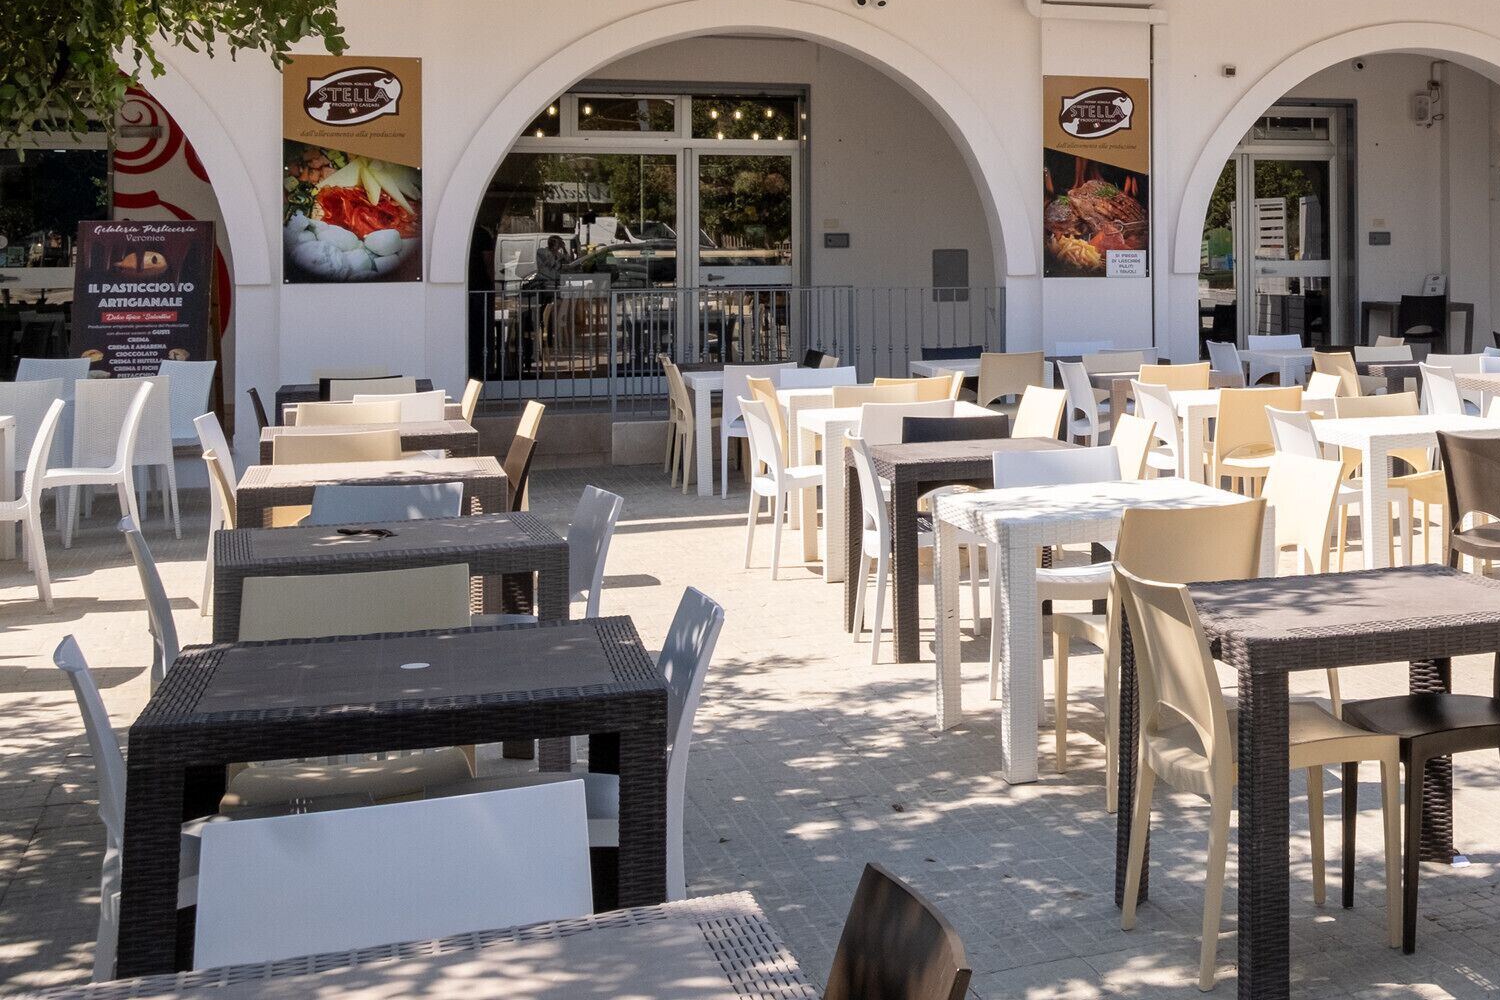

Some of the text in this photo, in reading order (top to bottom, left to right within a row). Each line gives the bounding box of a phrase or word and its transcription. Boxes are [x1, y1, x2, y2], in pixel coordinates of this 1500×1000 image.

[318, 87, 390, 103] STELLA
[1070, 104, 1124, 119] STELLA
[94, 224, 197, 235] Gelateria Pasticceria
[126, 234, 165, 242] Veronica
[88, 283, 100, 293] IL
[98, 297, 183, 308] ARTIGIANALE
